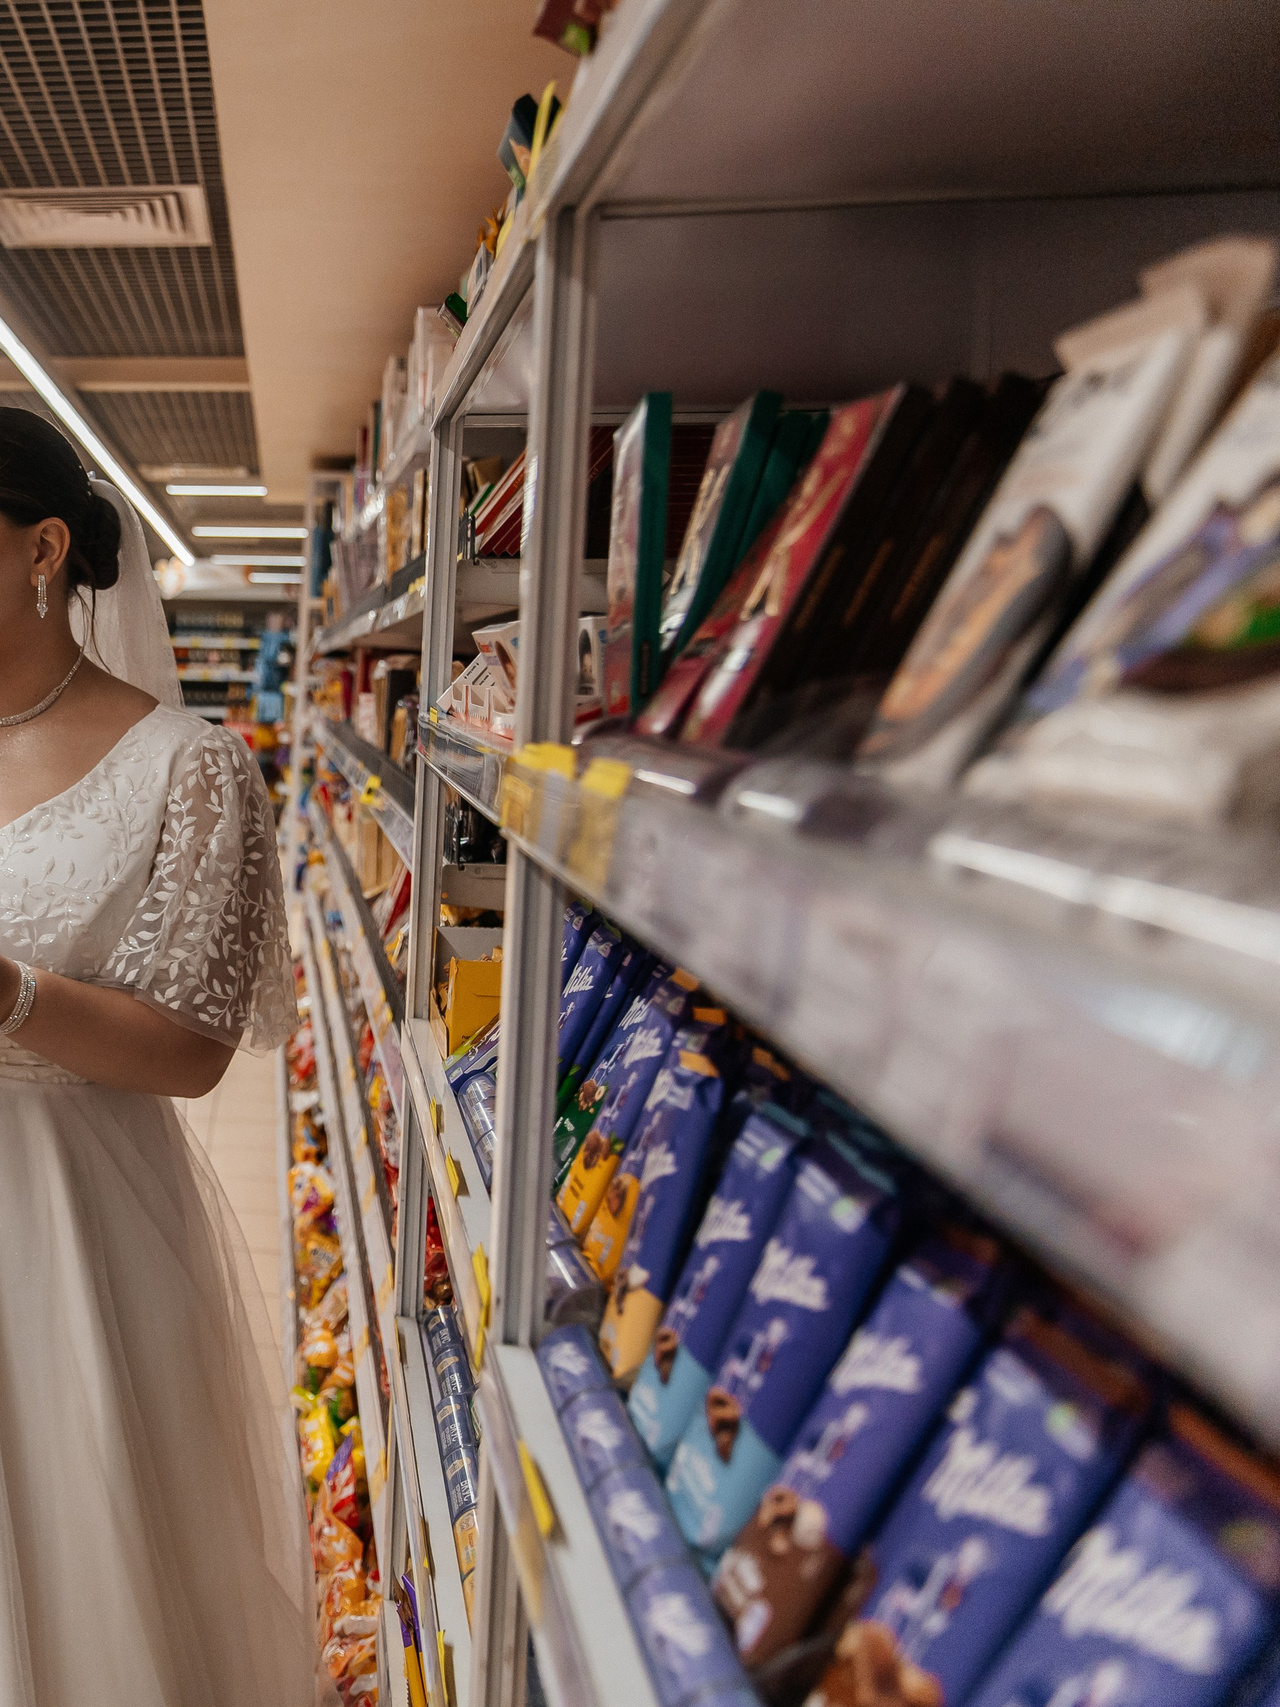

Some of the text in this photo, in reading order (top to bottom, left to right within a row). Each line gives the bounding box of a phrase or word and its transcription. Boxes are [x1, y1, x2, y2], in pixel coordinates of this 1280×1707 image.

[562, 962, 594, 999] Milka
[922, 1427, 1054, 1538] Milka
[1042, 1521, 1224, 1675] Milka
